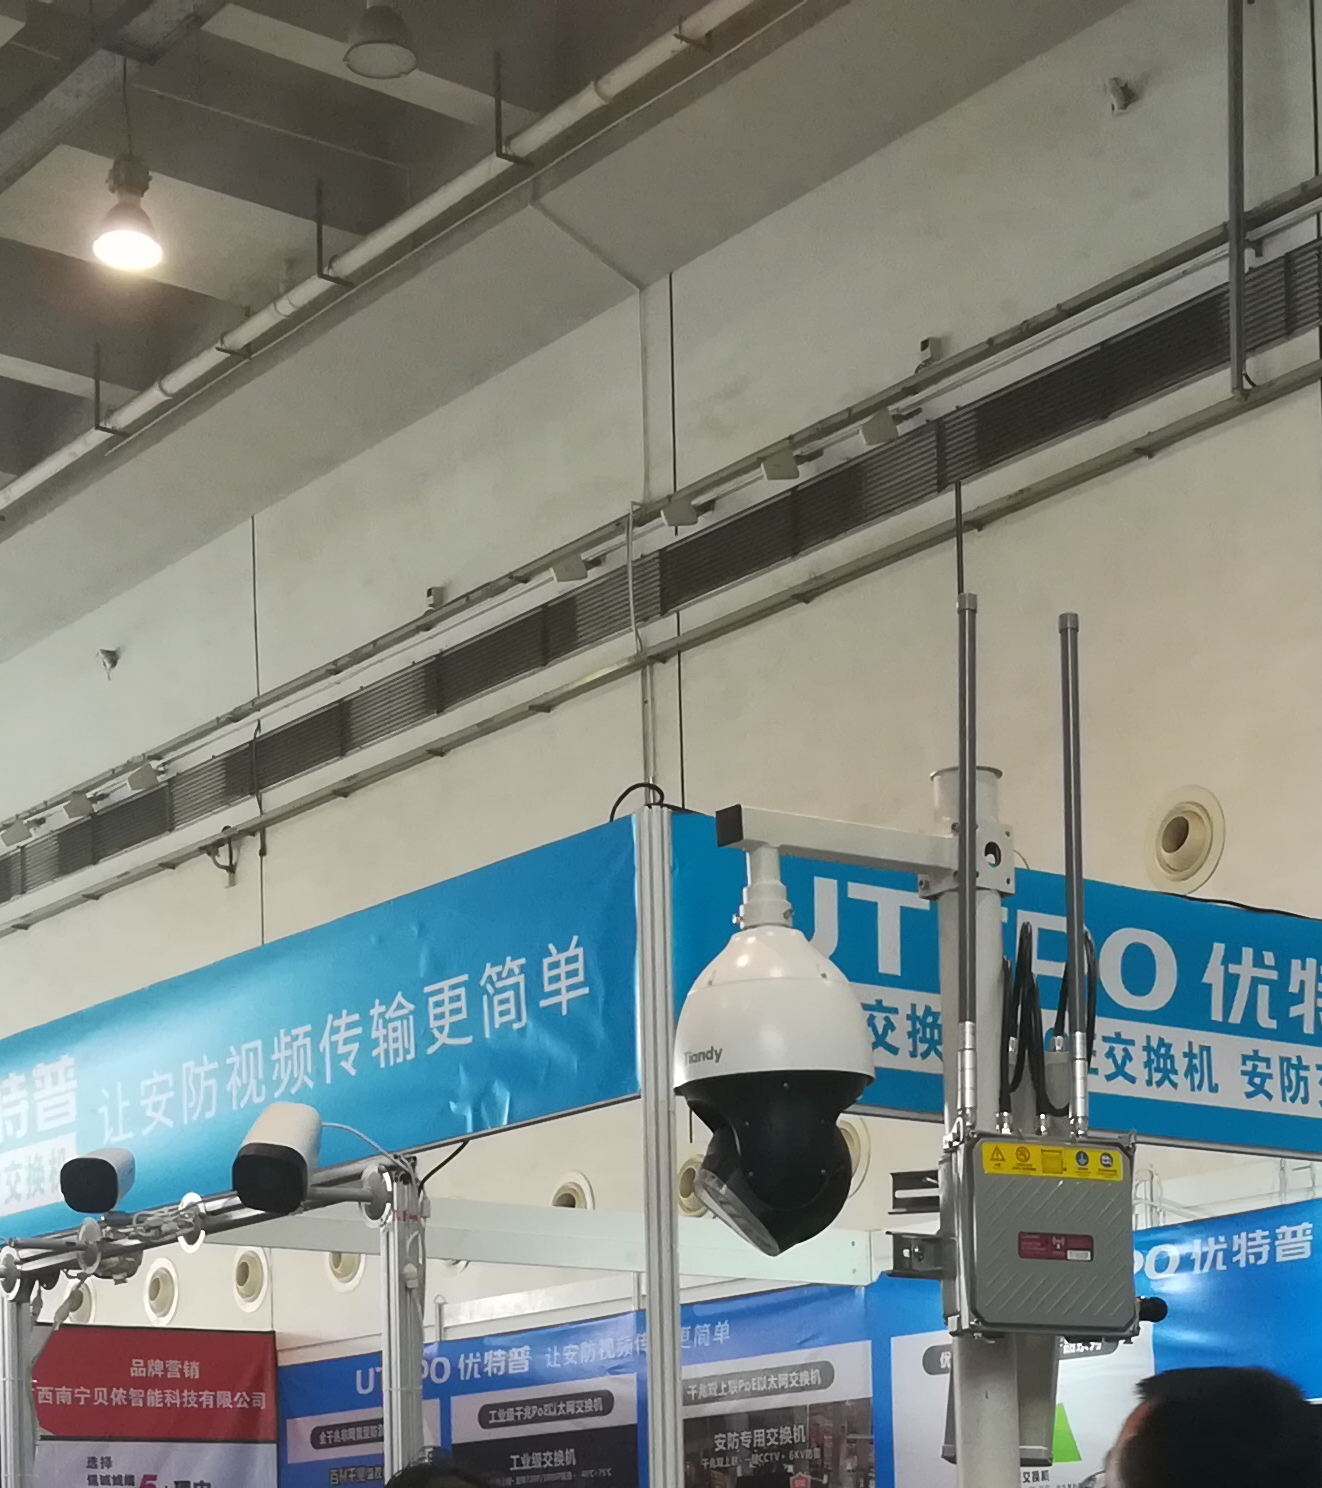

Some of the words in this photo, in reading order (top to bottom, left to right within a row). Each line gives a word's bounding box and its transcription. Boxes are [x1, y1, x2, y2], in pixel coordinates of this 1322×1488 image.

[807, 876, 1178, 1012] TPO
[97, 935, 591, 1145] 让安防视频传输更简单
[684, 1045, 723, 1065] Tiandy
[1191, 1222, 1315, 1273] 优特普
[130, 1359, 201, 1379] 品牌营销
[458, 1345, 531, 1381] 优特普
[31, 1386, 267, 1410] 西南宁贝侬智能科技有限公司
[713, 1424, 808, 1452] 安防专用交换机
[509, 1448, 577, 1471] 工业级交换机
